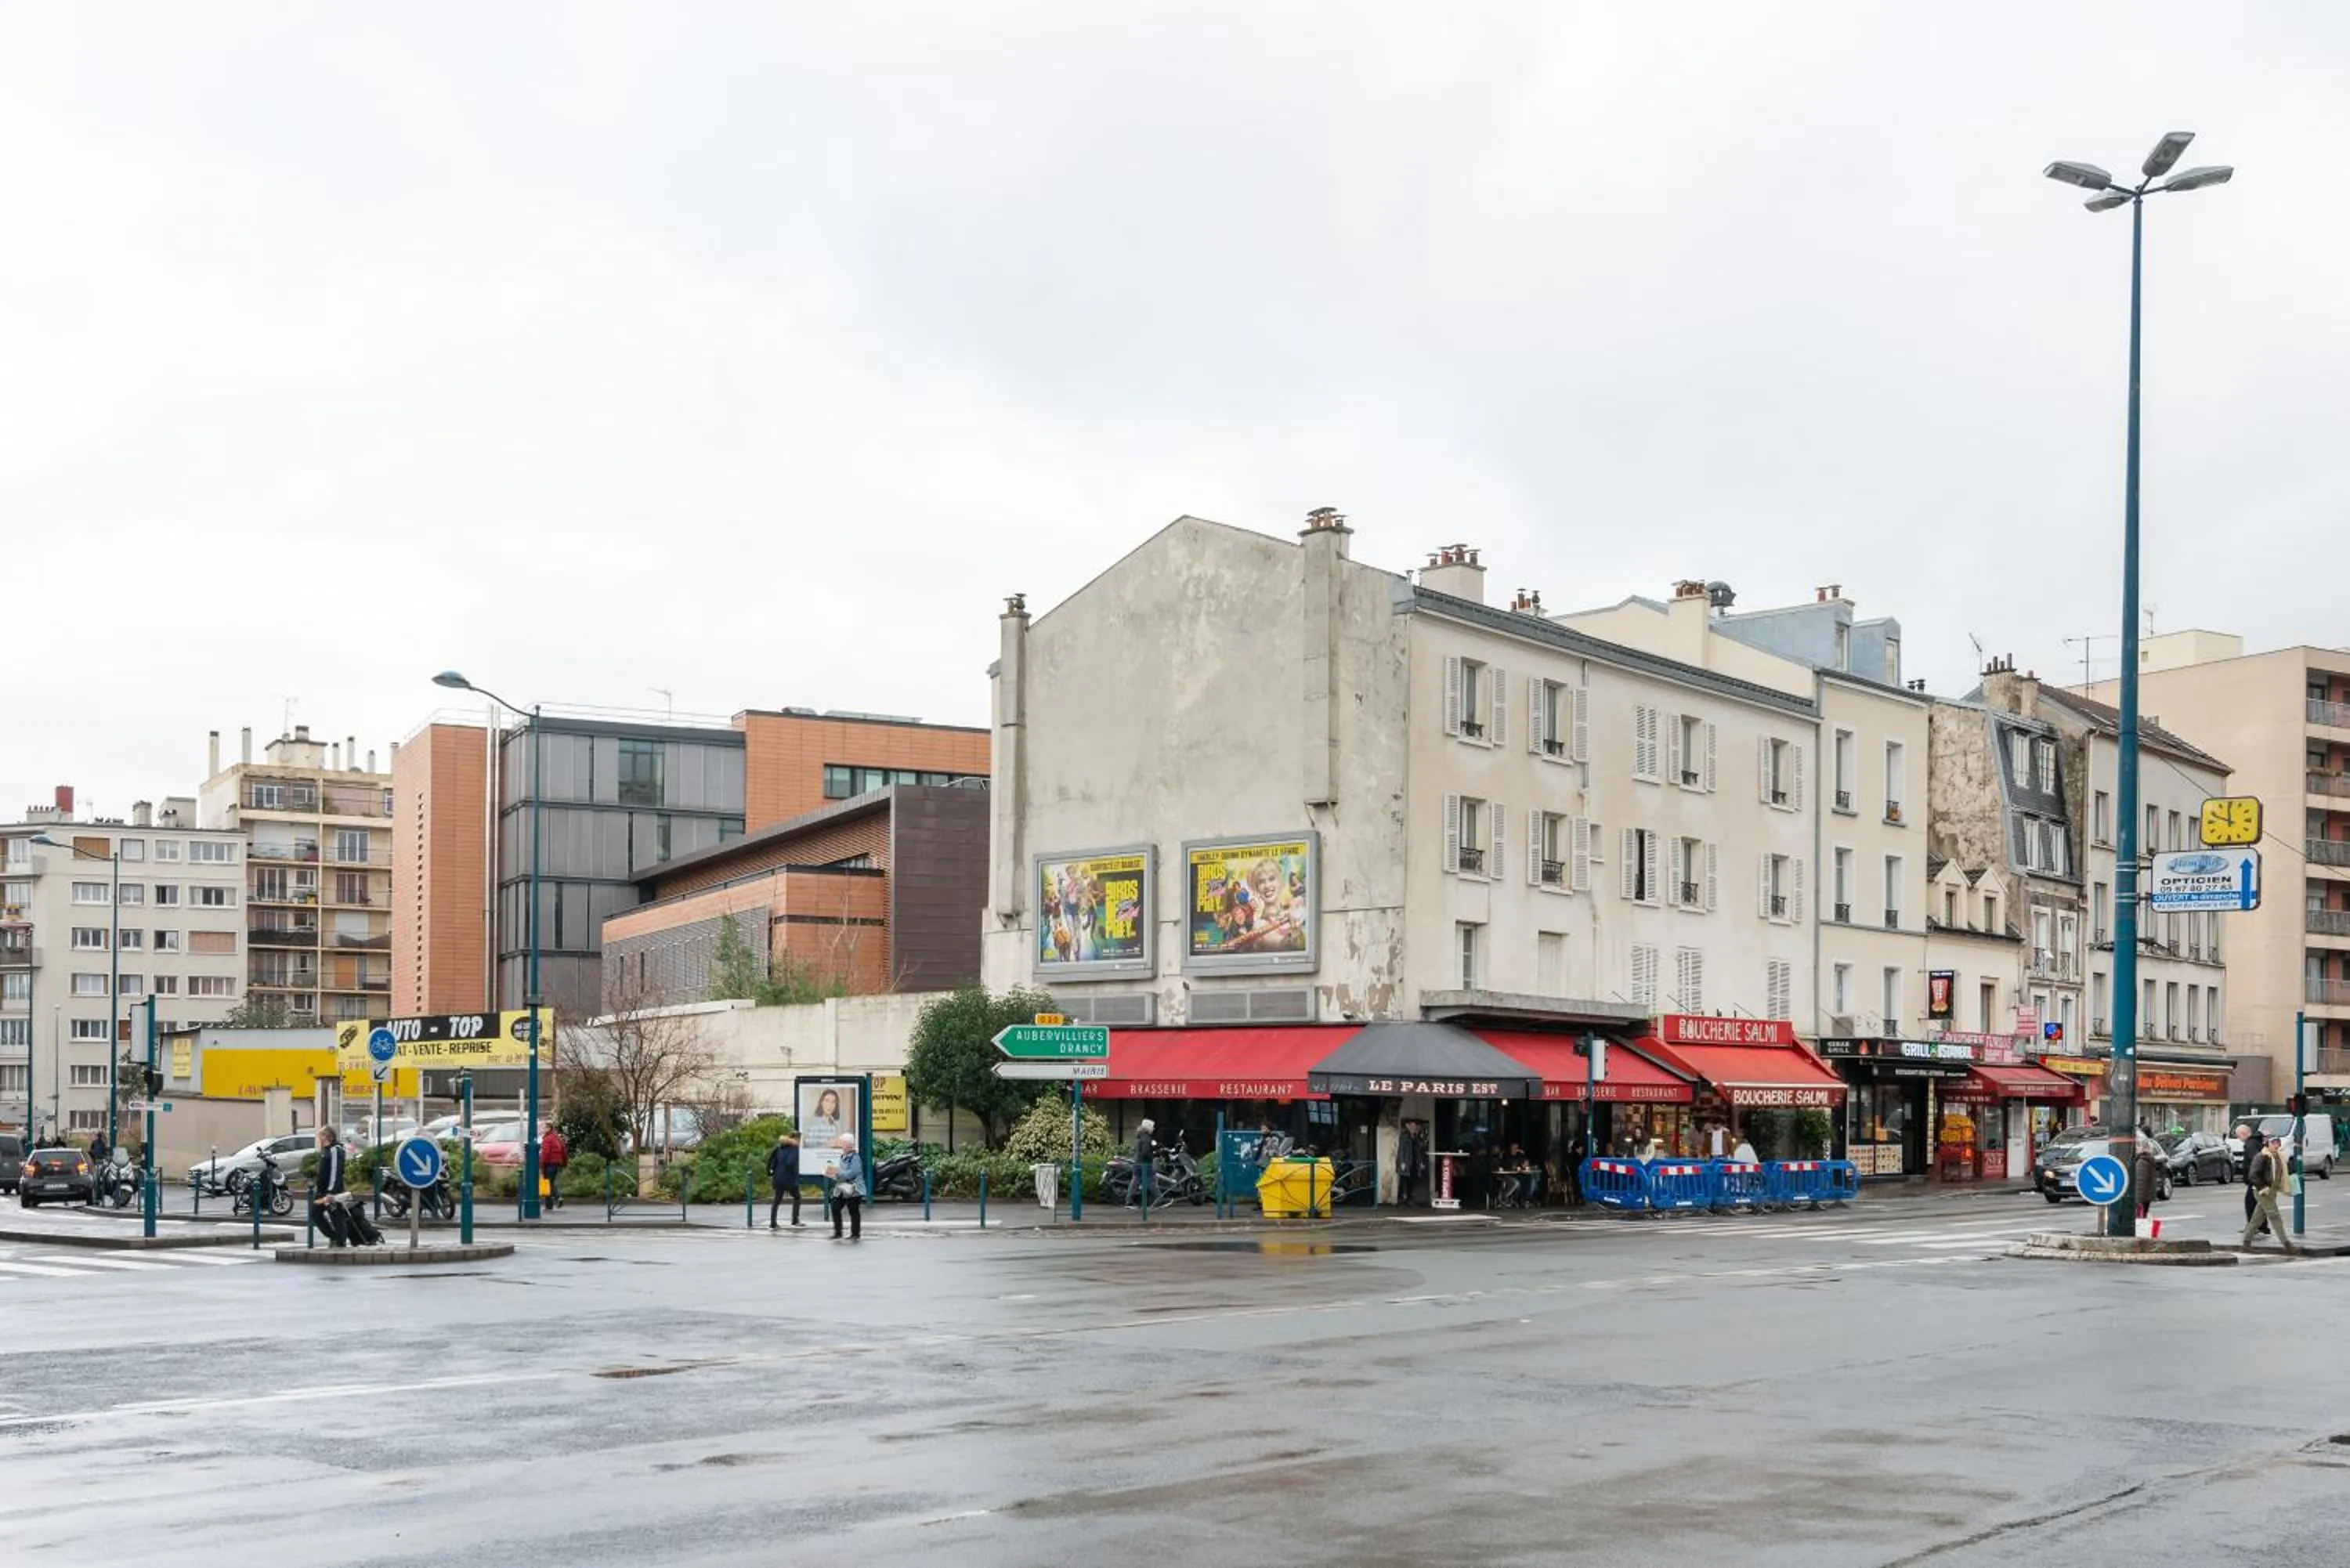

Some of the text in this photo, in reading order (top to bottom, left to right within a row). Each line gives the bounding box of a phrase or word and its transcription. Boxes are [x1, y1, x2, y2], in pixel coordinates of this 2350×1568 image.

[2160, 876, 2232, 885] OPTICIEN
[449, 1016, 483, 1038] TOP
[1679, 1018, 1777, 1042] BOUCHERIE SALMI
[1016, 1029, 1104, 1041] AUBERVILLIERS
[1060, 1043, 1104, 1053] DRANCY
[1902, 1042, 1931, 1057] GRILL
[1072, 1067, 1104, 1075] MAIRIE
[1130, 1083, 1188, 1094] BRASSERIE
[1220, 1082, 1292, 1095] RESTAURANT
[1368, 1079, 1392, 1091] LE
[1401, 1081, 1465, 1094] PARIS
[1472, 1082, 1498, 1094] EST
[1544, 1086, 1679, 1097] BAR BRSSERIE RESTAURANT
[1734, 1089, 1829, 1105] BOUCHERIE SALMI
